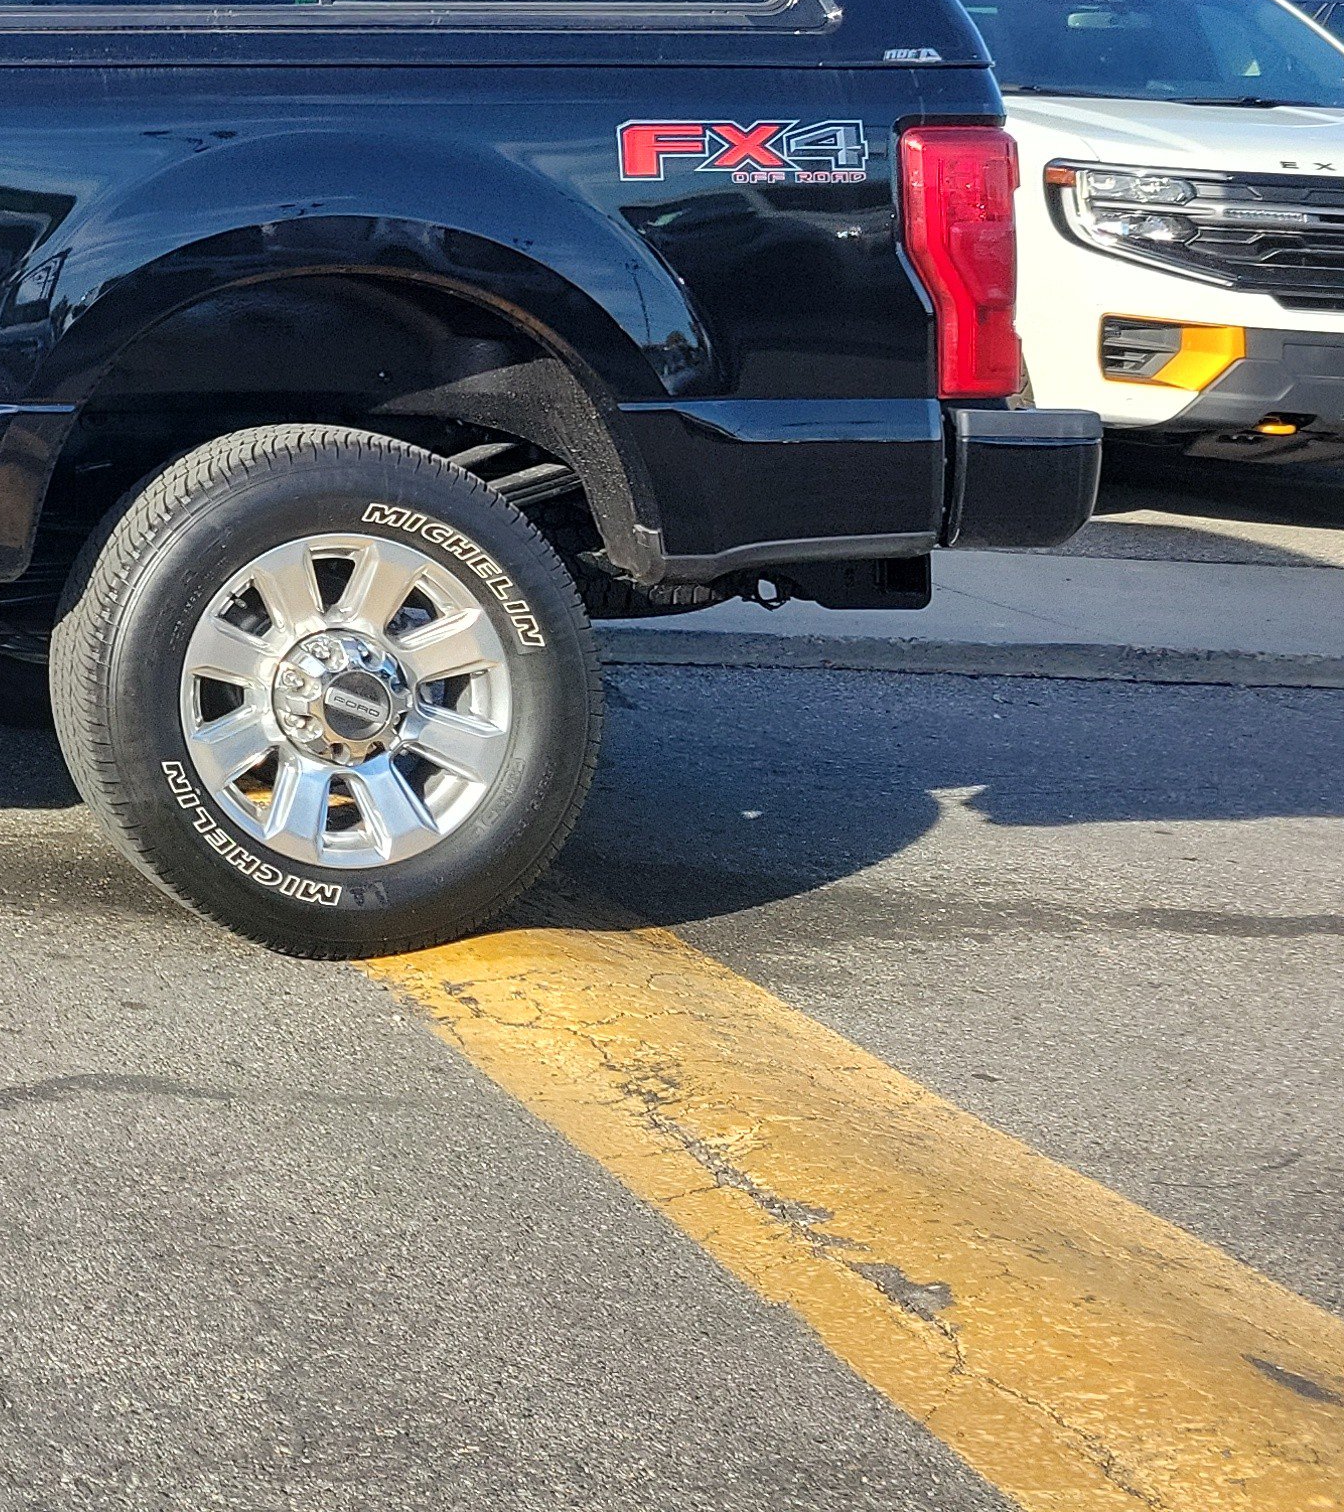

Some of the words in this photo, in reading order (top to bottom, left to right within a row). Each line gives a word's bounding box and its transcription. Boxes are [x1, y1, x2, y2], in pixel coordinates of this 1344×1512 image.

[616, 119, 869, 181] FX4
[731, 171, 786, 185] OFF
[794, 171, 868, 185] ROAD
[362, 502, 546, 648] MICHELIN
[333, 695, 380, 718] FORD
[161, 760, 342, 907] MICHELIN
